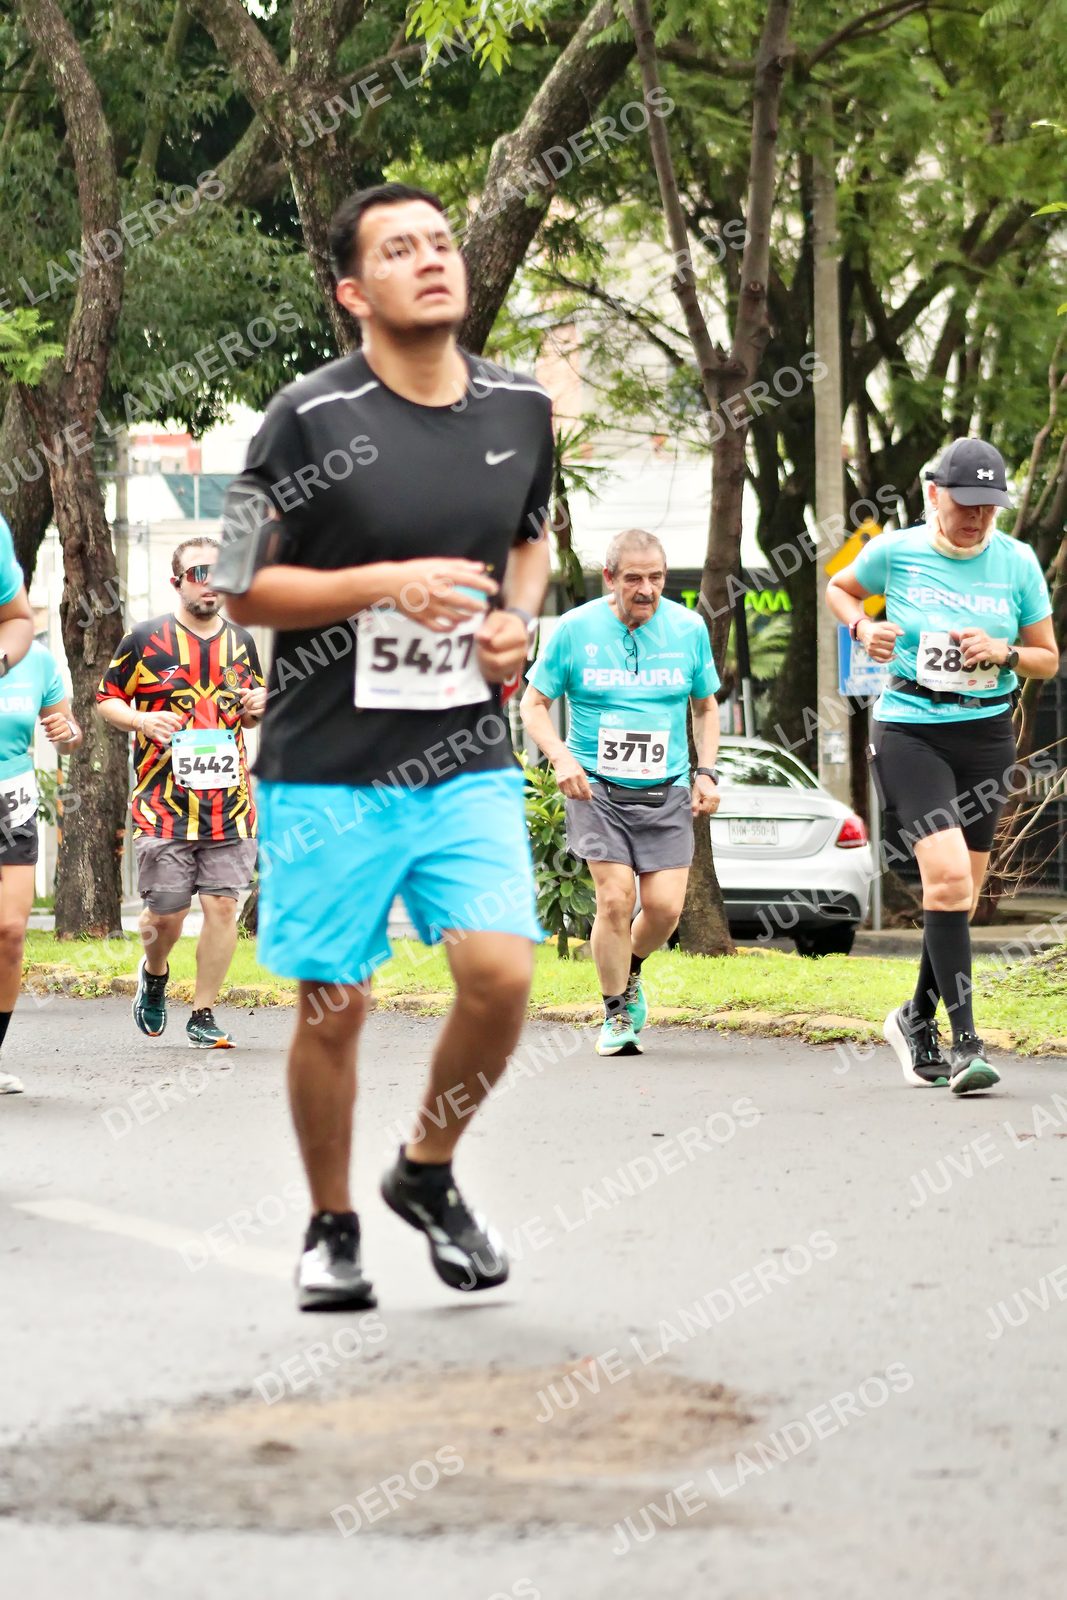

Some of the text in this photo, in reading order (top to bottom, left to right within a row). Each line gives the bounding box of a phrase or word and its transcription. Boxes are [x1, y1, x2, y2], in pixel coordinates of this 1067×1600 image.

[907, 587, 1010, 615] PERDURA
[371, 634, 474, 674] 5427
[583, 667, 685, 687] PERDURA
[603, 740, 665, 763] 3719
[178, 755, 234, 775] 5442
